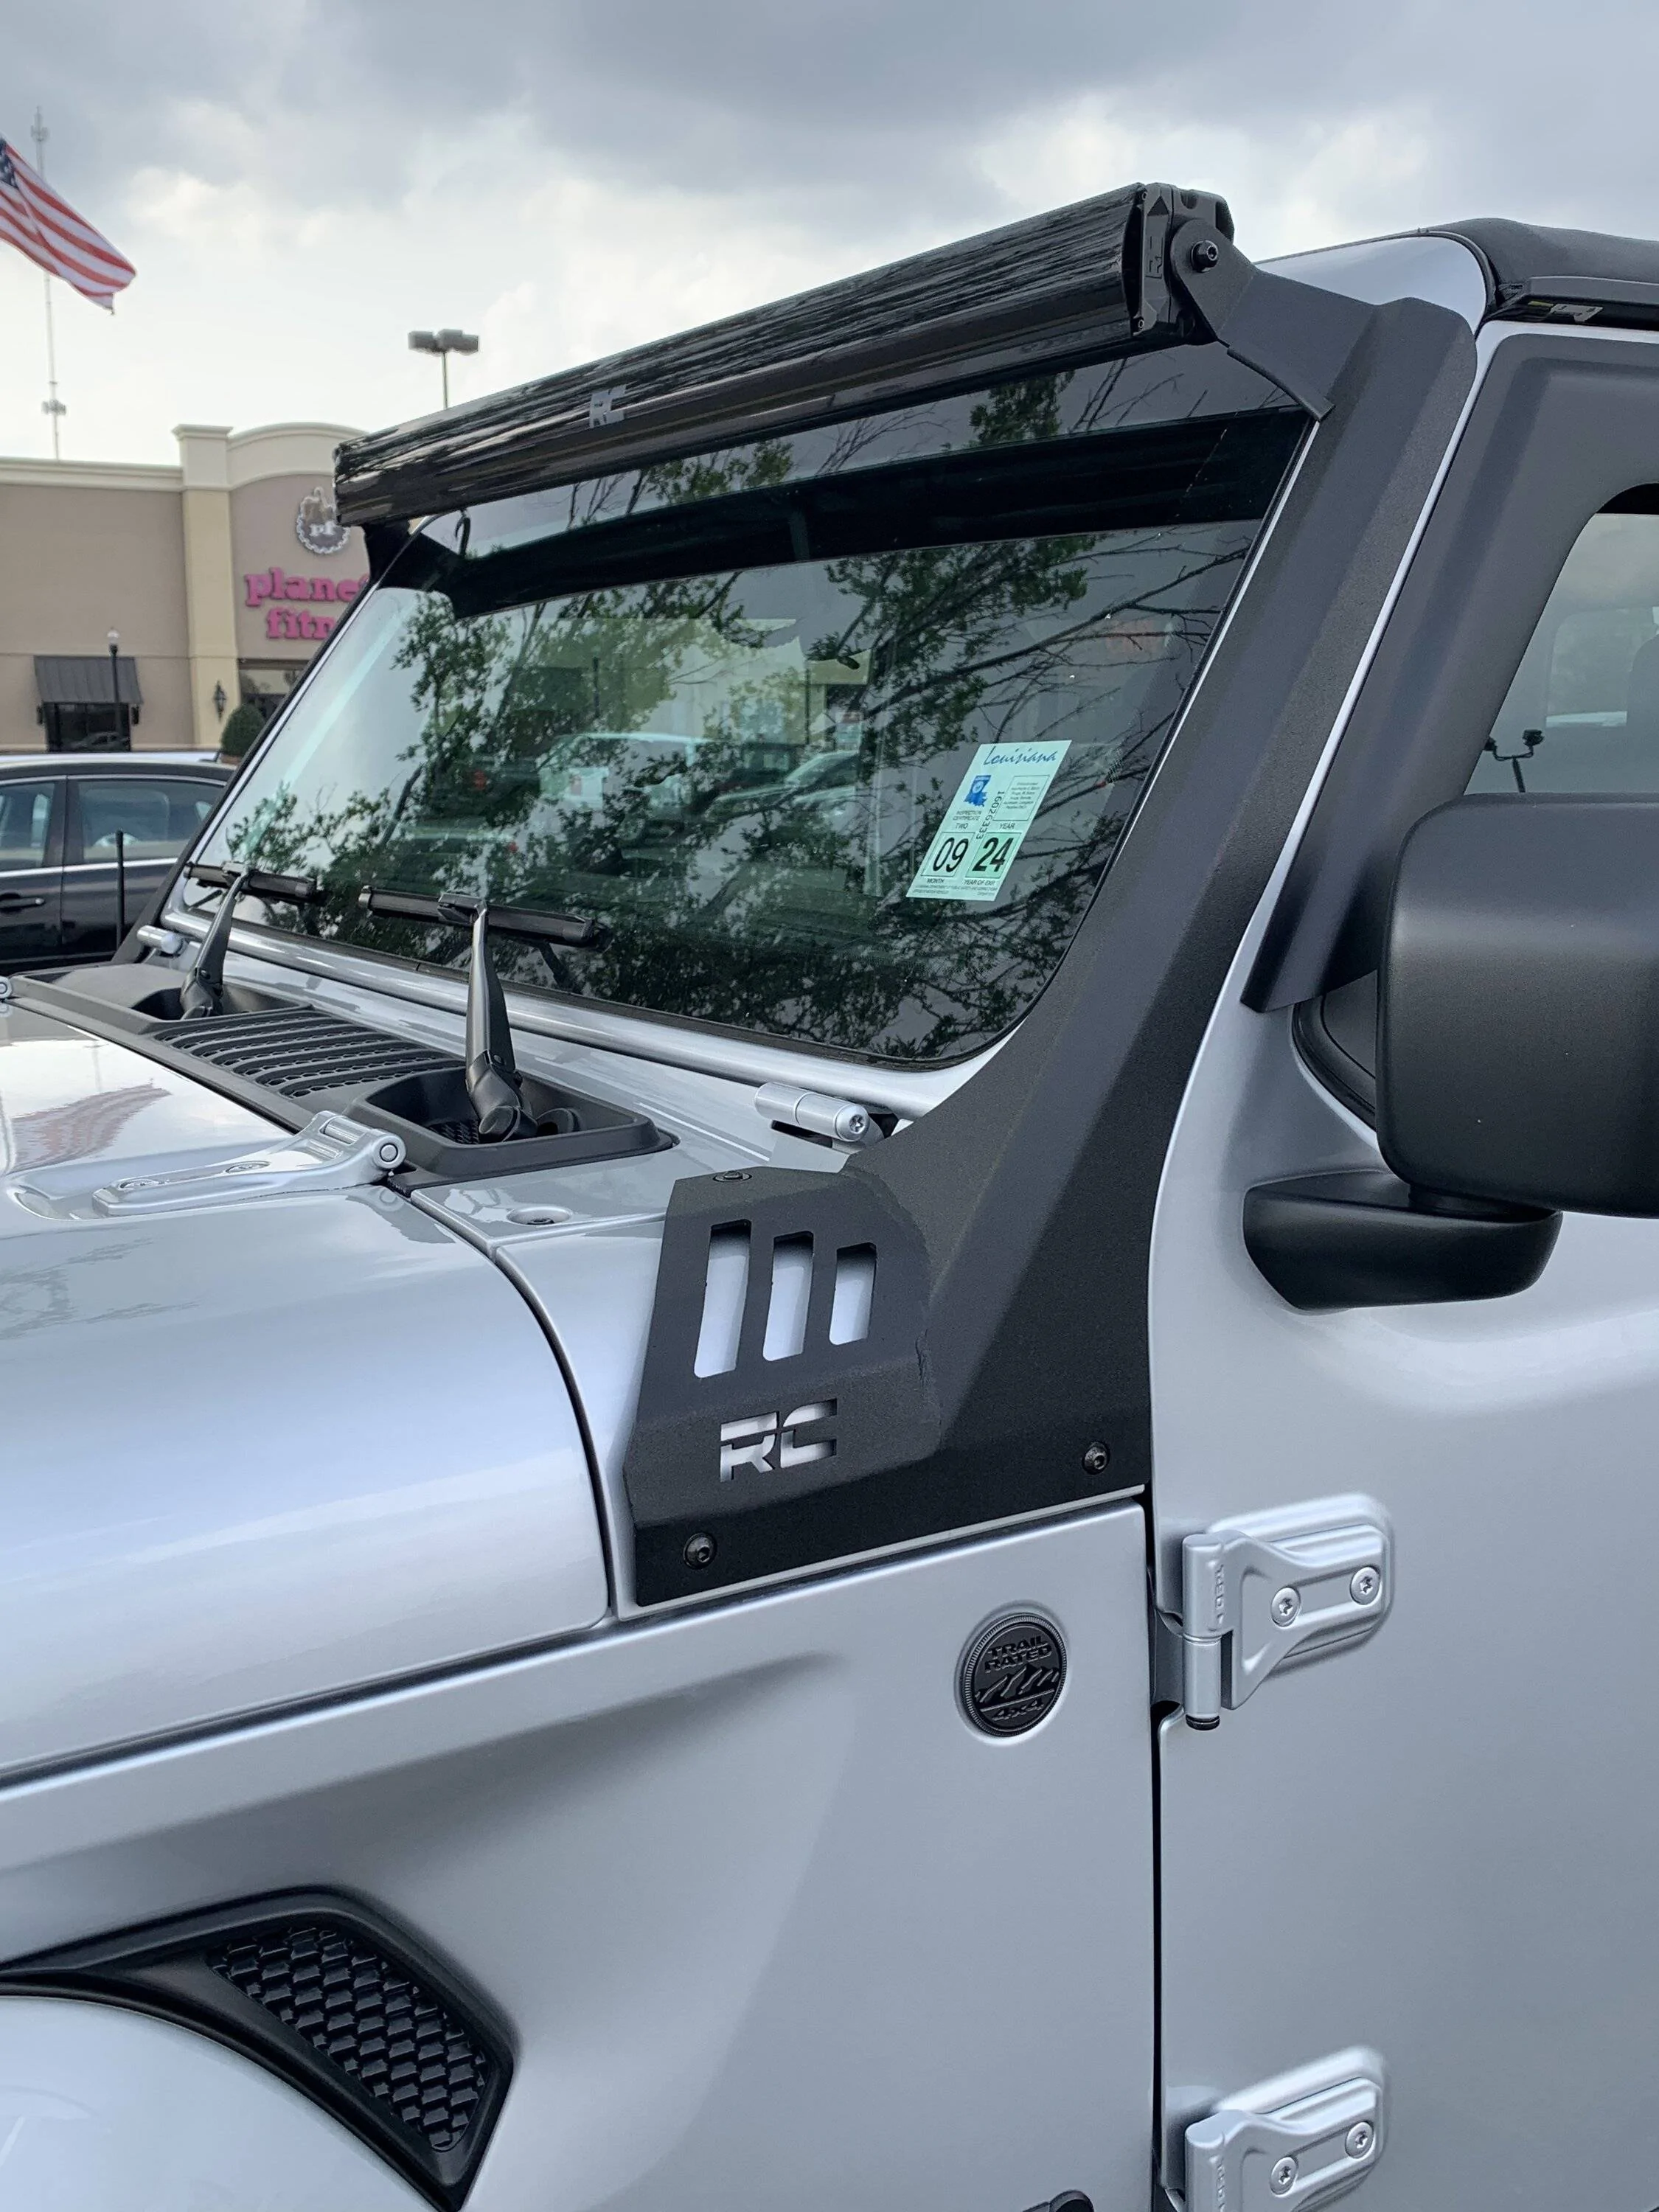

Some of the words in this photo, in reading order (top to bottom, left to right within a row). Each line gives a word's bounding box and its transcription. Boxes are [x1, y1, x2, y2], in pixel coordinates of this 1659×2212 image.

[983, 745, 1058, 766] Louisiana
[975, 790, 1005, 840] 16026333
[933, 837, 969, 873] 09
[972, 837, 1014, 872] 24
[720, 1398, 838, 1484] RC
[984, 1644, 1053, 1674] RATED
[988, 1635, 1048, 1660] TRAIL
